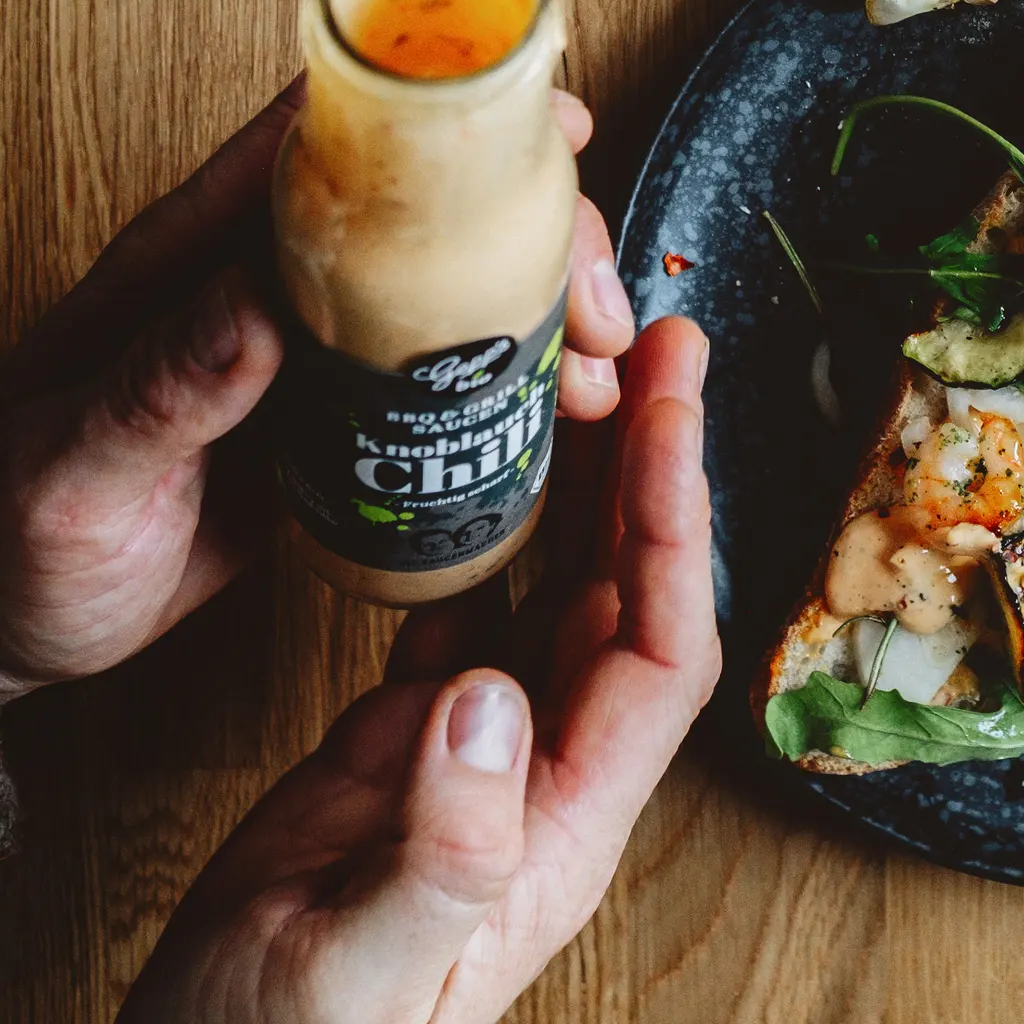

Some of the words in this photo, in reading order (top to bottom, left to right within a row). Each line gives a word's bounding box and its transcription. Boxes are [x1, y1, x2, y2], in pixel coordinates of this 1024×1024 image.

[354, 397, 544, 495] Chili
[356, 382, 546, 459] Knoblauch
[412, 398, 509, 435] SAUCEN
